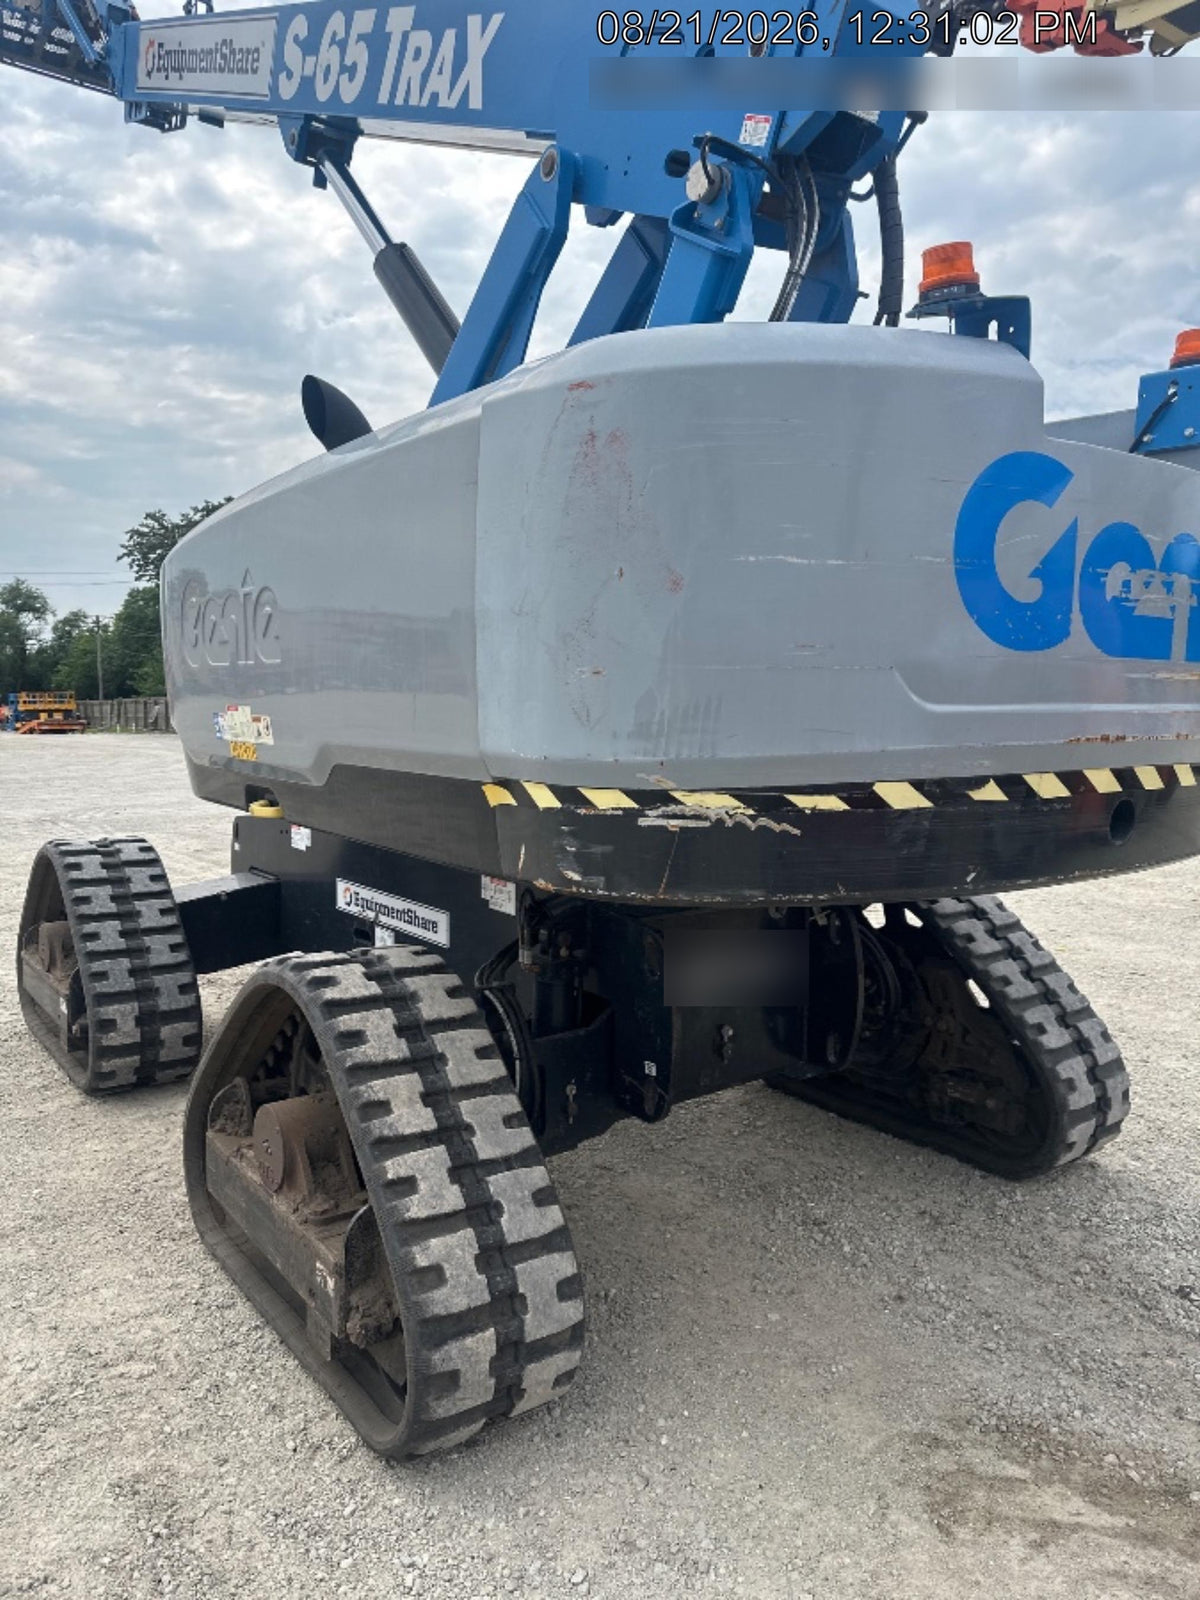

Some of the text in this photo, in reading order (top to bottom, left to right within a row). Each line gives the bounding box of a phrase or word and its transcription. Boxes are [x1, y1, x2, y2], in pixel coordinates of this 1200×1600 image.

[156, 39, 261, 80] EquipmentShare
[278, 9, 378, 104] S-65
[353, 890, 439, 934] EquipmentShare
